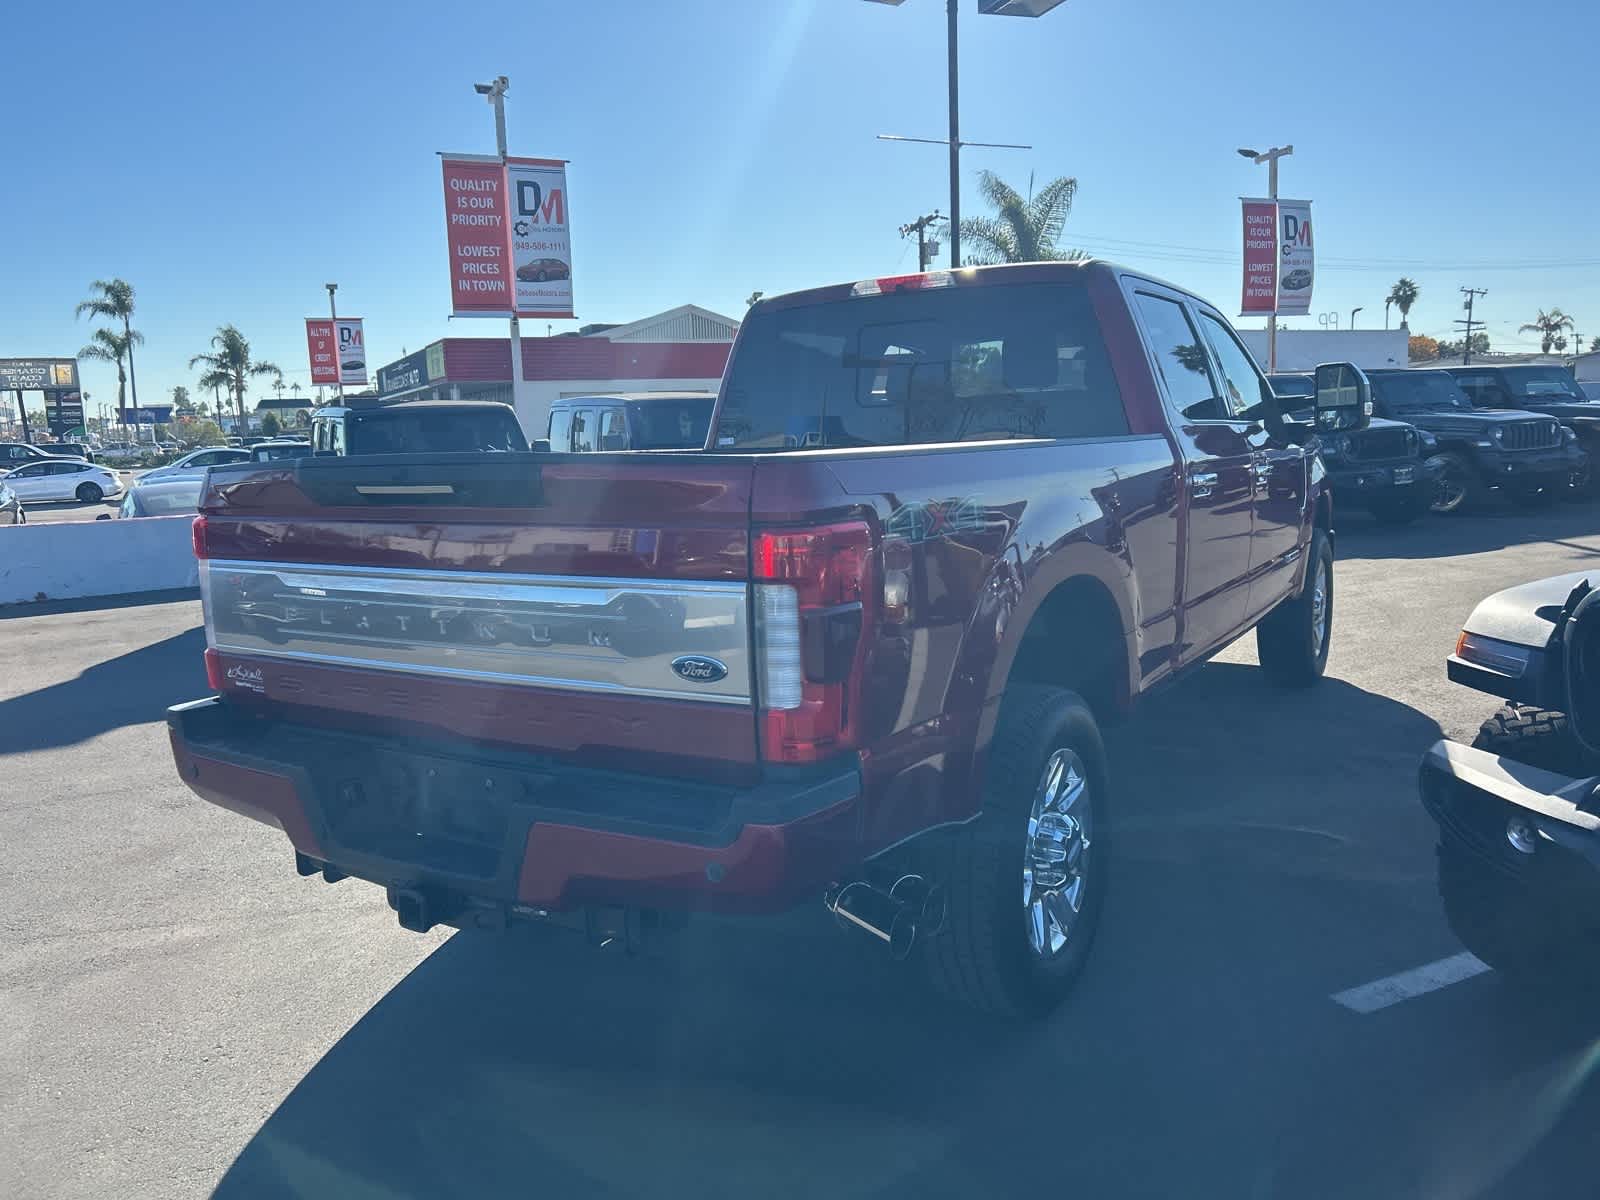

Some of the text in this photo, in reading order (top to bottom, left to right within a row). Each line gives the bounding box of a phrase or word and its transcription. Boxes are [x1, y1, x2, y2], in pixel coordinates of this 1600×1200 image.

[450, 178, 498, 192] QUALITY
[457, 197, 495, 209] IS OUR
[451, 214, 502, 227] PRIORITY
[1246, 215, 1273, 225] QUALITY
[1250, 228, 1271, 237] IS OUR
[1246, 240, 1274, 249] PRIORITY
[457, 245, 502, 258] LOWEST
[462, 263, 500, 275] PRICES
[1248, 263, 1274, 272] LOWEST
[1249, 275, 1272, 285] PRICES
[458, 280, 506, 293] IN TOWN
[1246, 288, 1254, 297] IN
[1255, 288, 1274, 297] TOWN
[310, 327, 331, 337] ALL TYPE
[681, 660, 713, 677] Ford
